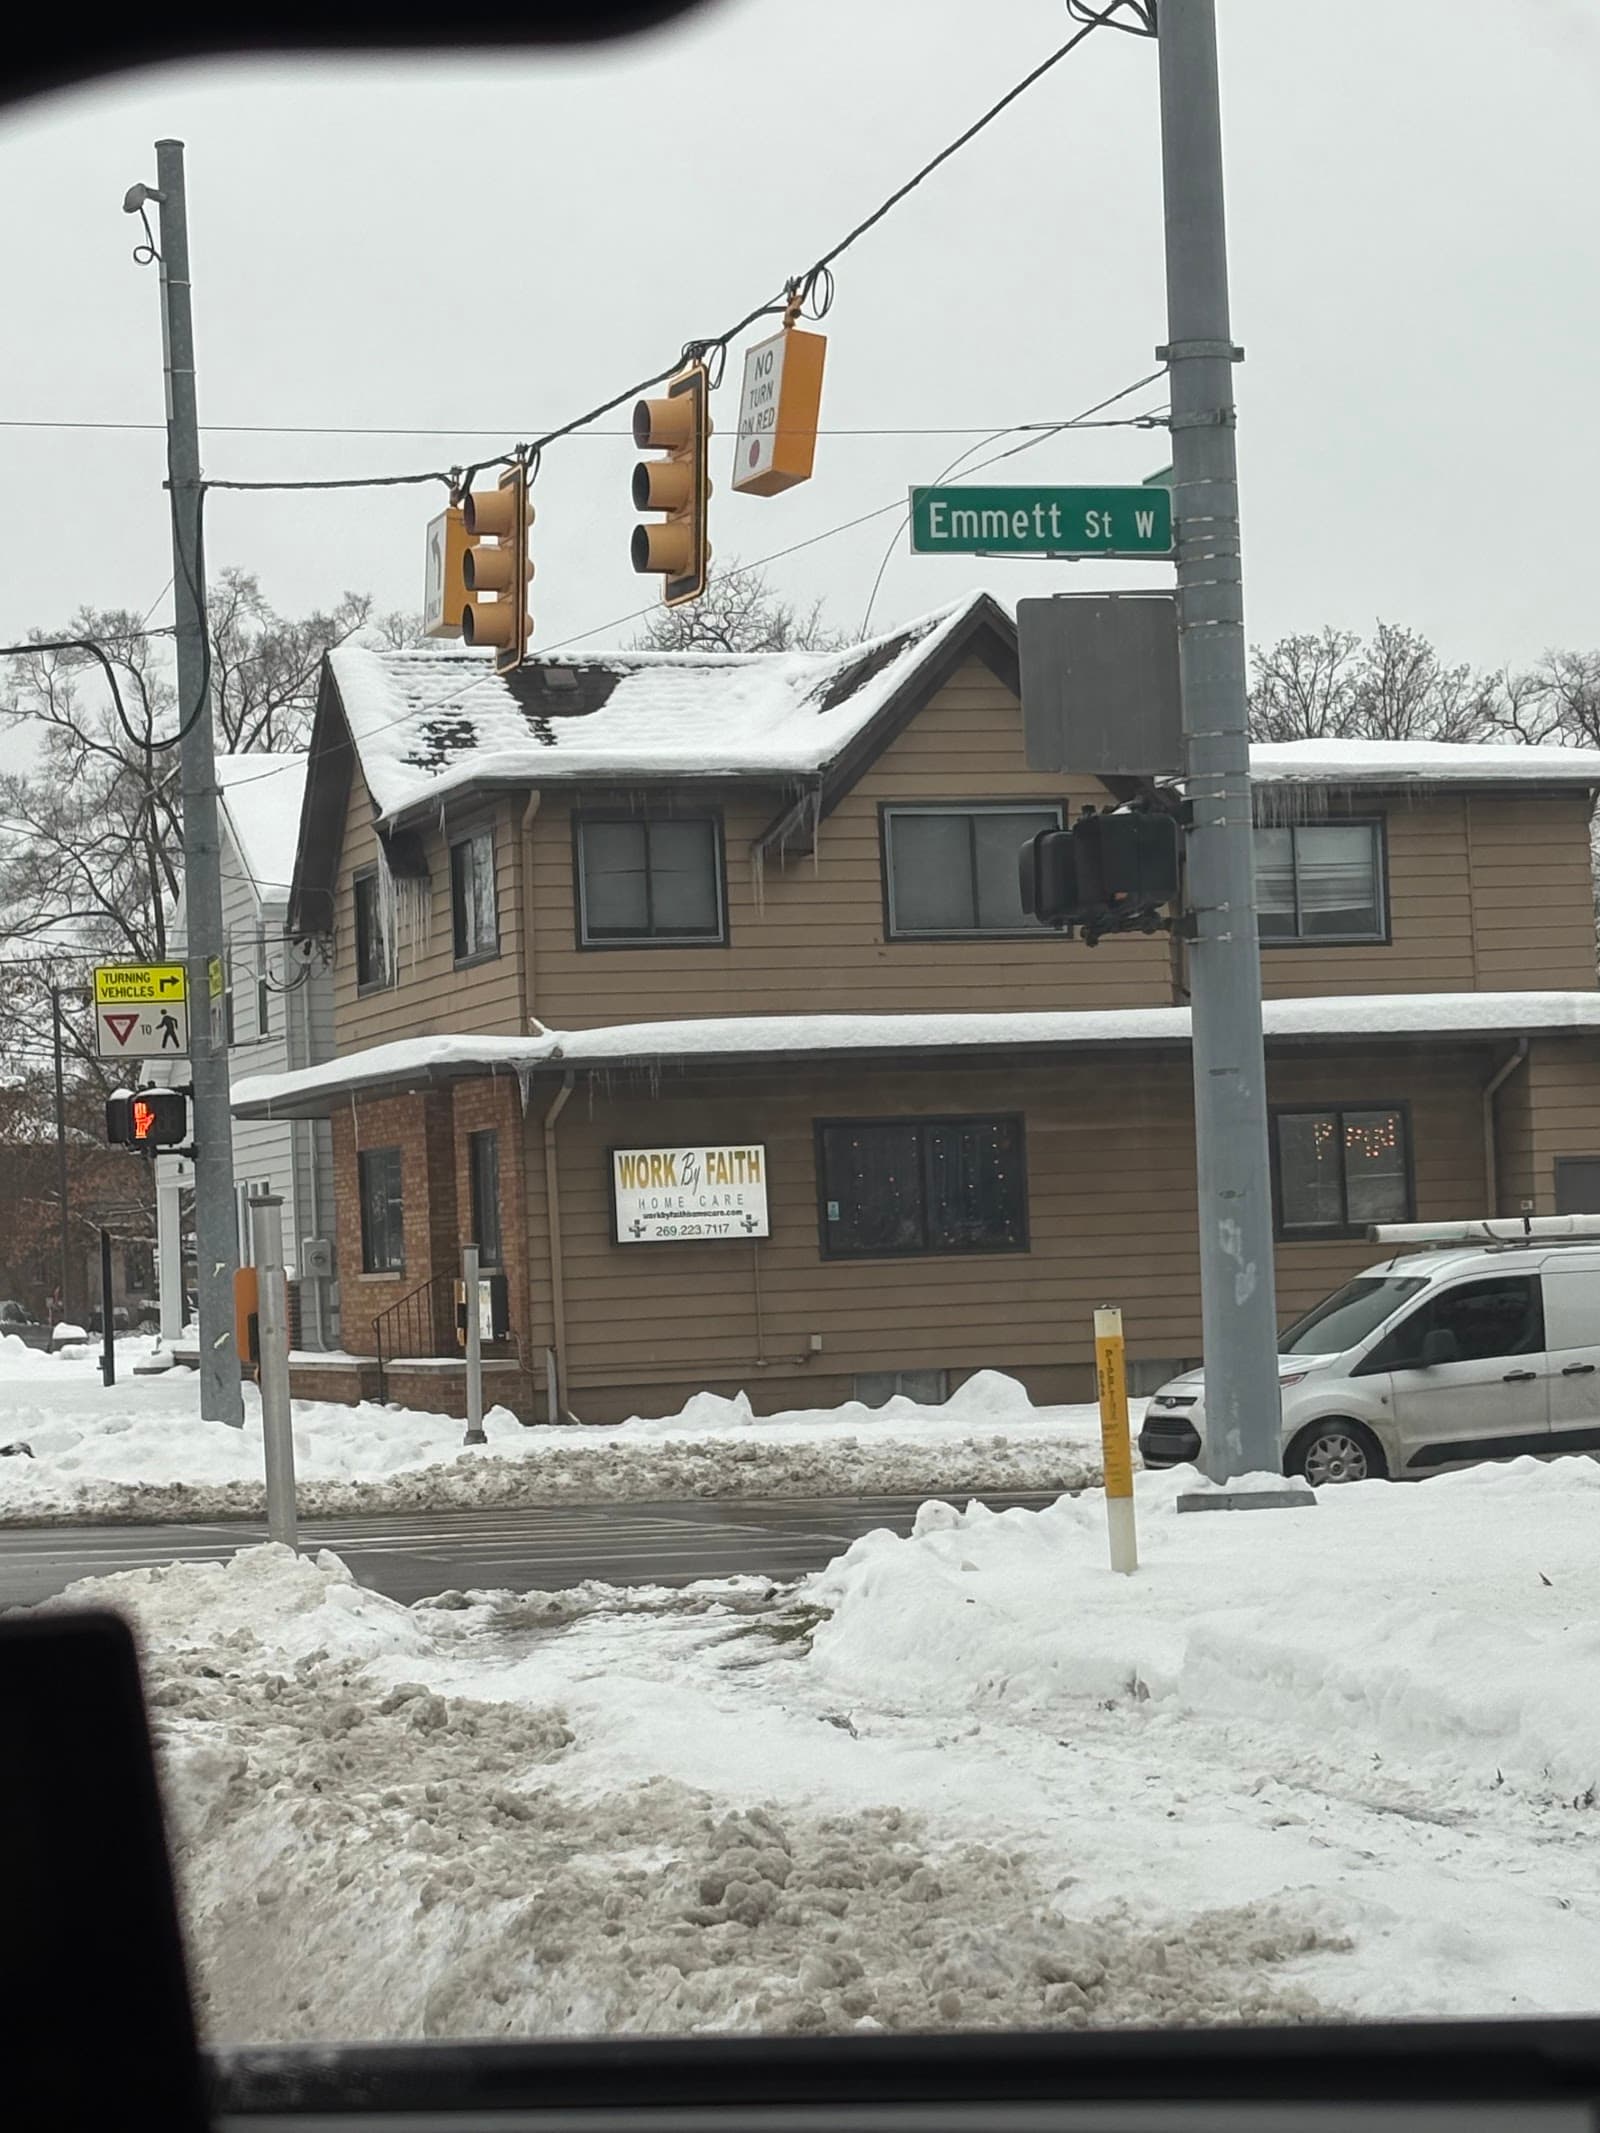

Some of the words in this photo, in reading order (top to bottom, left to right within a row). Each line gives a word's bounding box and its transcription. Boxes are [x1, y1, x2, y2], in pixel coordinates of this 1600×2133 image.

[755, 350, 773, 381] NO
[750, 380, 774, 410] TURN
[741, 419, 753, 440] ON
[756, 407, 775, 433] RED
[929, 502, 1062, 539] Emmett
[1085, 510, 1112, 538] St
[1135, 510, 1154, 538] W
[103, 972, 151, 984] TURNING
[101, 986, 155, 998] VEHICLES
[140, 1024, 152, 1035] TO
[618, 1153, 677, 1189] WORK
[681, 1152, 701, 1196] By
[705, 1150, 761, 1185] FAITH
[638, 1196, 685, 1210] HOME
[699, 1194, 744, 1207] CARE
[656, 1224, 730, 1237] 269.223.7117
